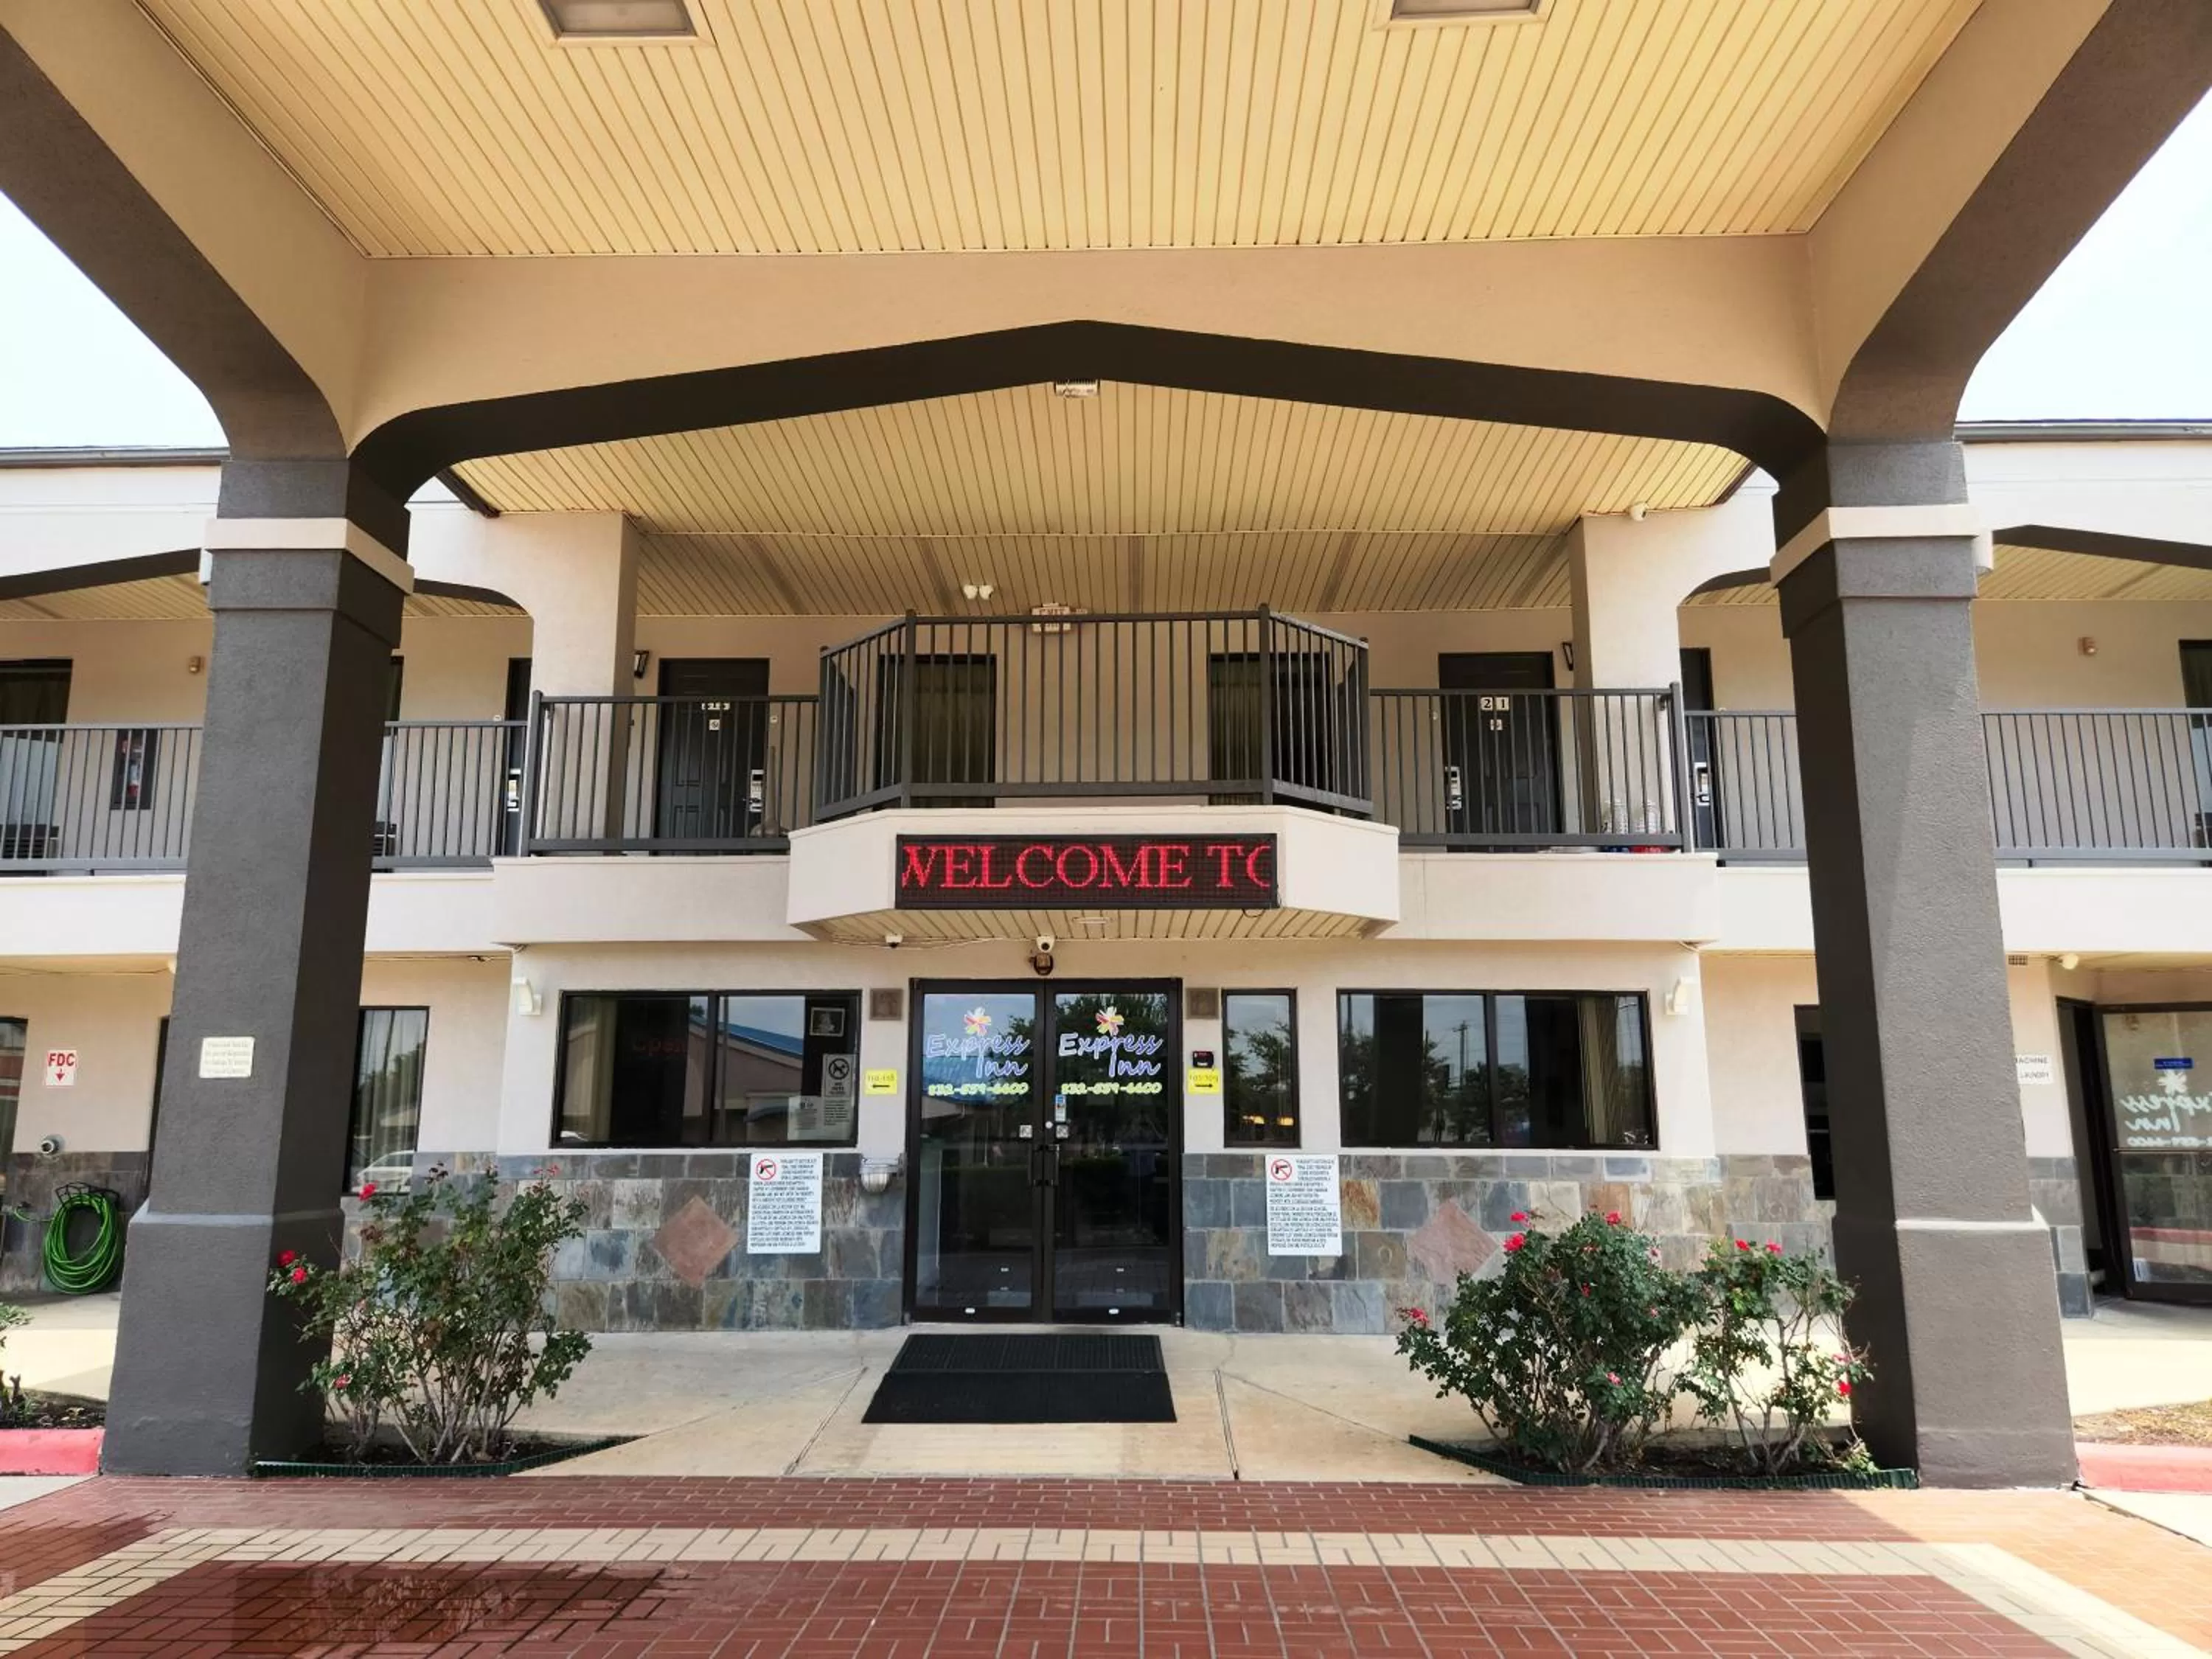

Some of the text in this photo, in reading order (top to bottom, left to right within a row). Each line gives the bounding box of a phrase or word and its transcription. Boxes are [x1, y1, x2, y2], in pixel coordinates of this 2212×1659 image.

[902, 845, 1192, 888] WELCOME
[926, 1033, 1031, 1060] Express
[1059, 1032, 1164, 1060] Express
[48, 1053, 74, 1067] FDC
[975, 1053, 1029, 1078] Inn
[1108, 1053, 1161, 1077] Inn
